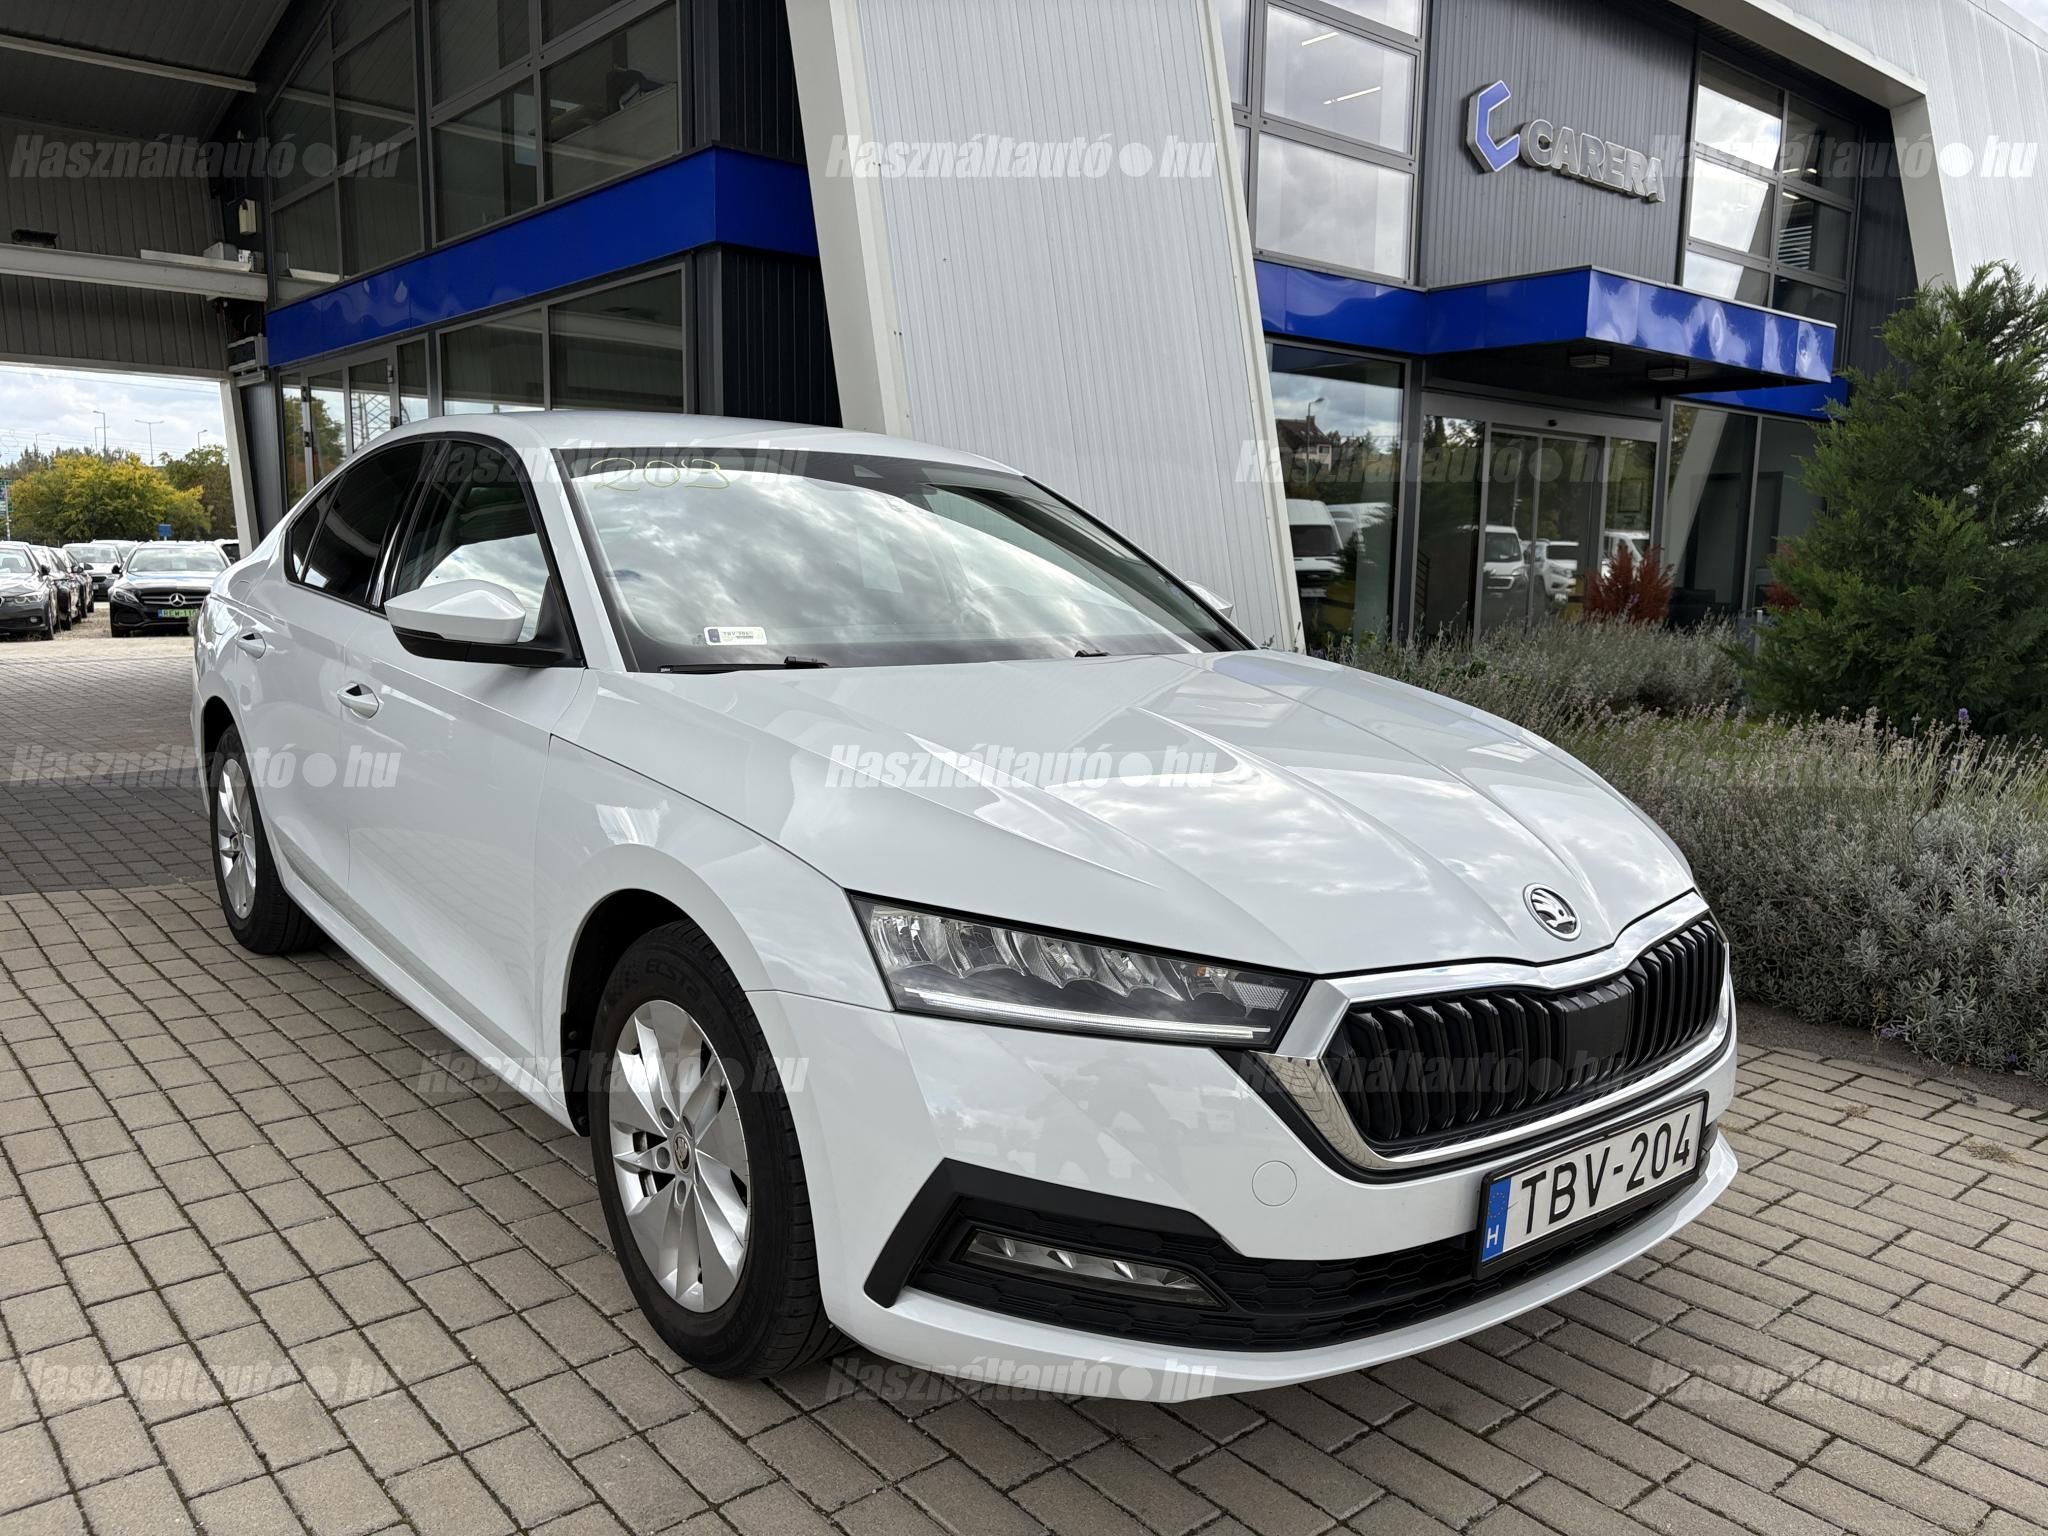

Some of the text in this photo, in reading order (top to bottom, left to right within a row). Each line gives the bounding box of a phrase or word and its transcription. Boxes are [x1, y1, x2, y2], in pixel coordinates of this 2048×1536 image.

[1520, 119, 1665, 203] CARERA
[1486, 1112, 1691, 1249] H TBV-204
